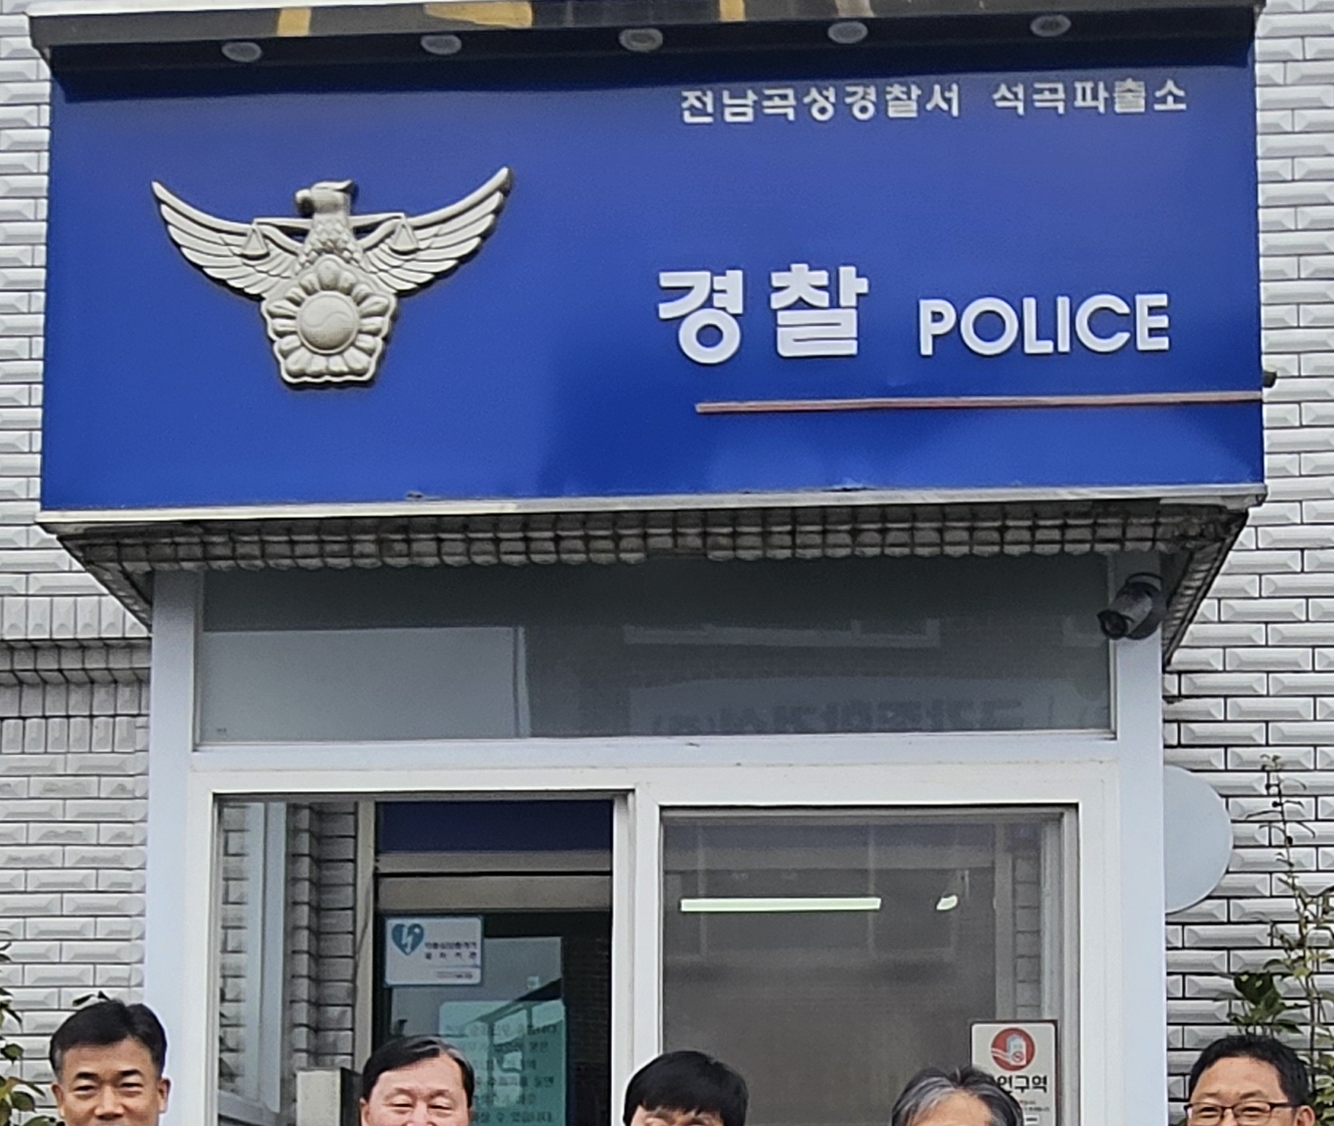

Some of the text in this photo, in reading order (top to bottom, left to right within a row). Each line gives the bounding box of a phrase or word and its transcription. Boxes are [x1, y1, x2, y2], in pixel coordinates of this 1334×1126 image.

[679, 77, 1187, 124] 전남곡성경찰서 석곡파출소
[658, 262, 1170, 365] 경찰 POLICE
[997, 1075, 1048, 1094] 연구역
